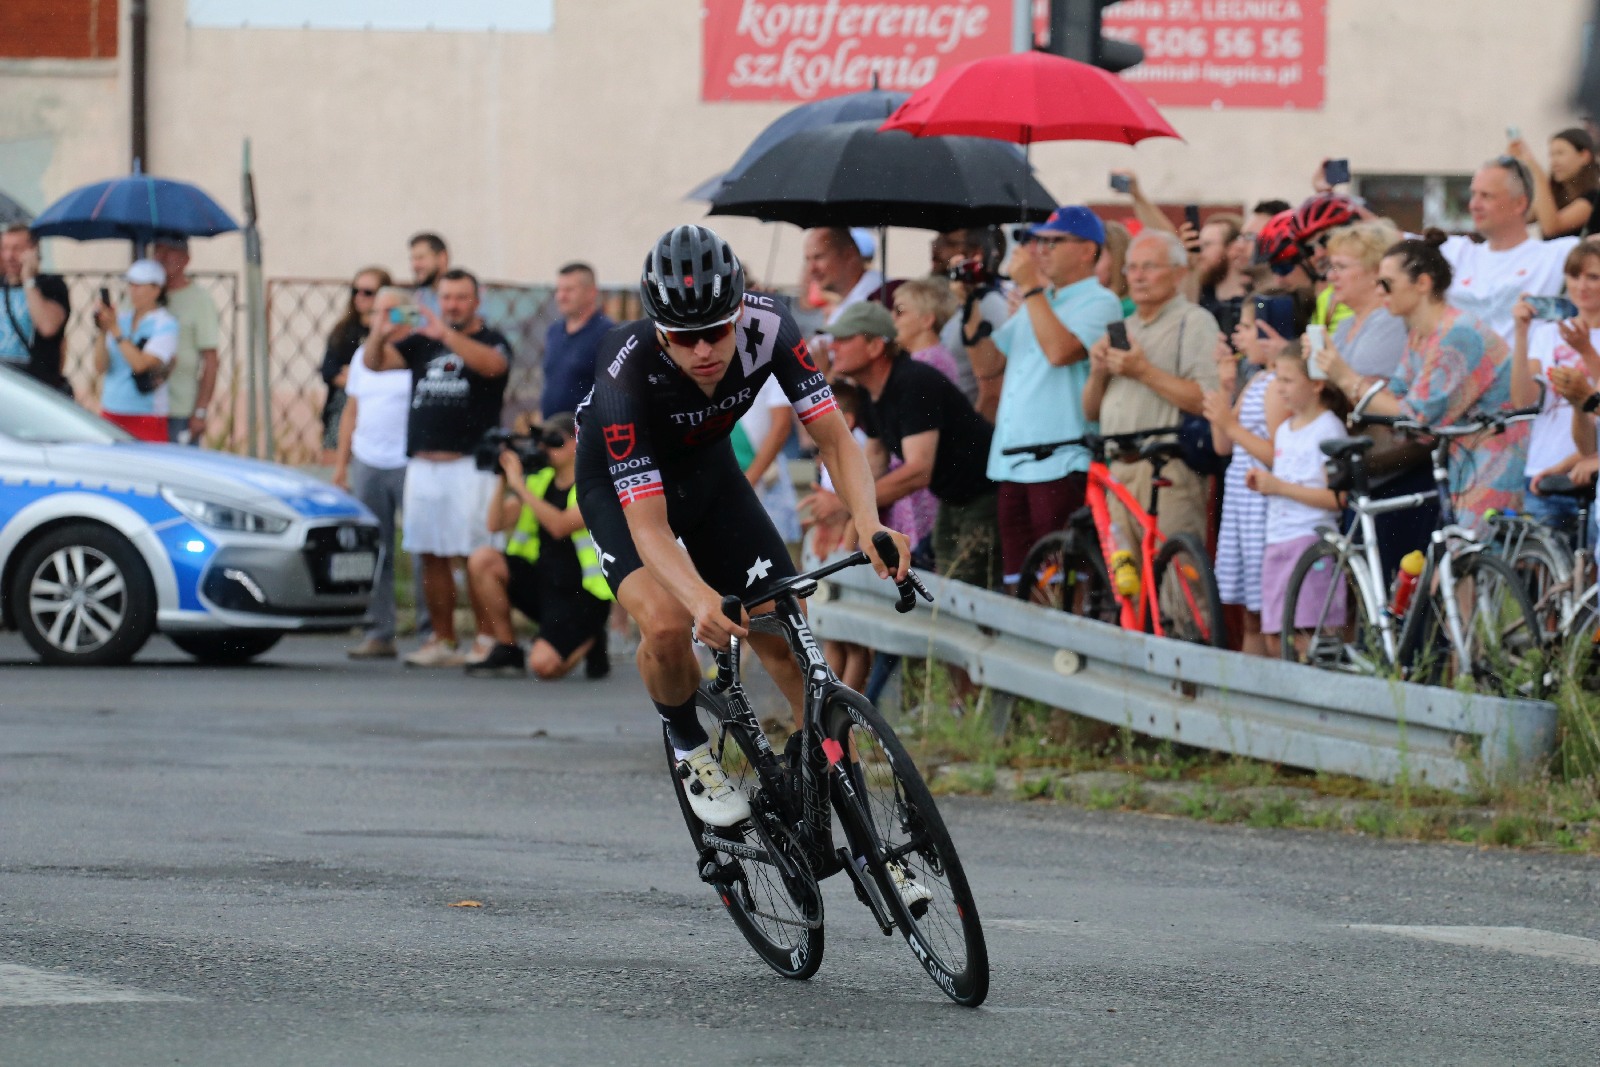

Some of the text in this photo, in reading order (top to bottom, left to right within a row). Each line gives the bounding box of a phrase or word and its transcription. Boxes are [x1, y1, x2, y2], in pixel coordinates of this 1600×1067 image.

[736, 0, 989, 53] konferencje
[1145, 27, 1208, 58] 506
[1213, 27, 1256, 58] 56
[1260, 27, 1304, 58] 56
[727, 38, 939, 98] szkolenia
[743, 292, 774, 308] MC
[607, 334, 639, 379] BMC
[797, 371, 824, 391] TUD
[810, 388, 834, 405] BO
[670, 387, 752, 426] TUDOR
[609, 456, 652, 475] UDOR
[928, 960, 958, 996] SWISS
